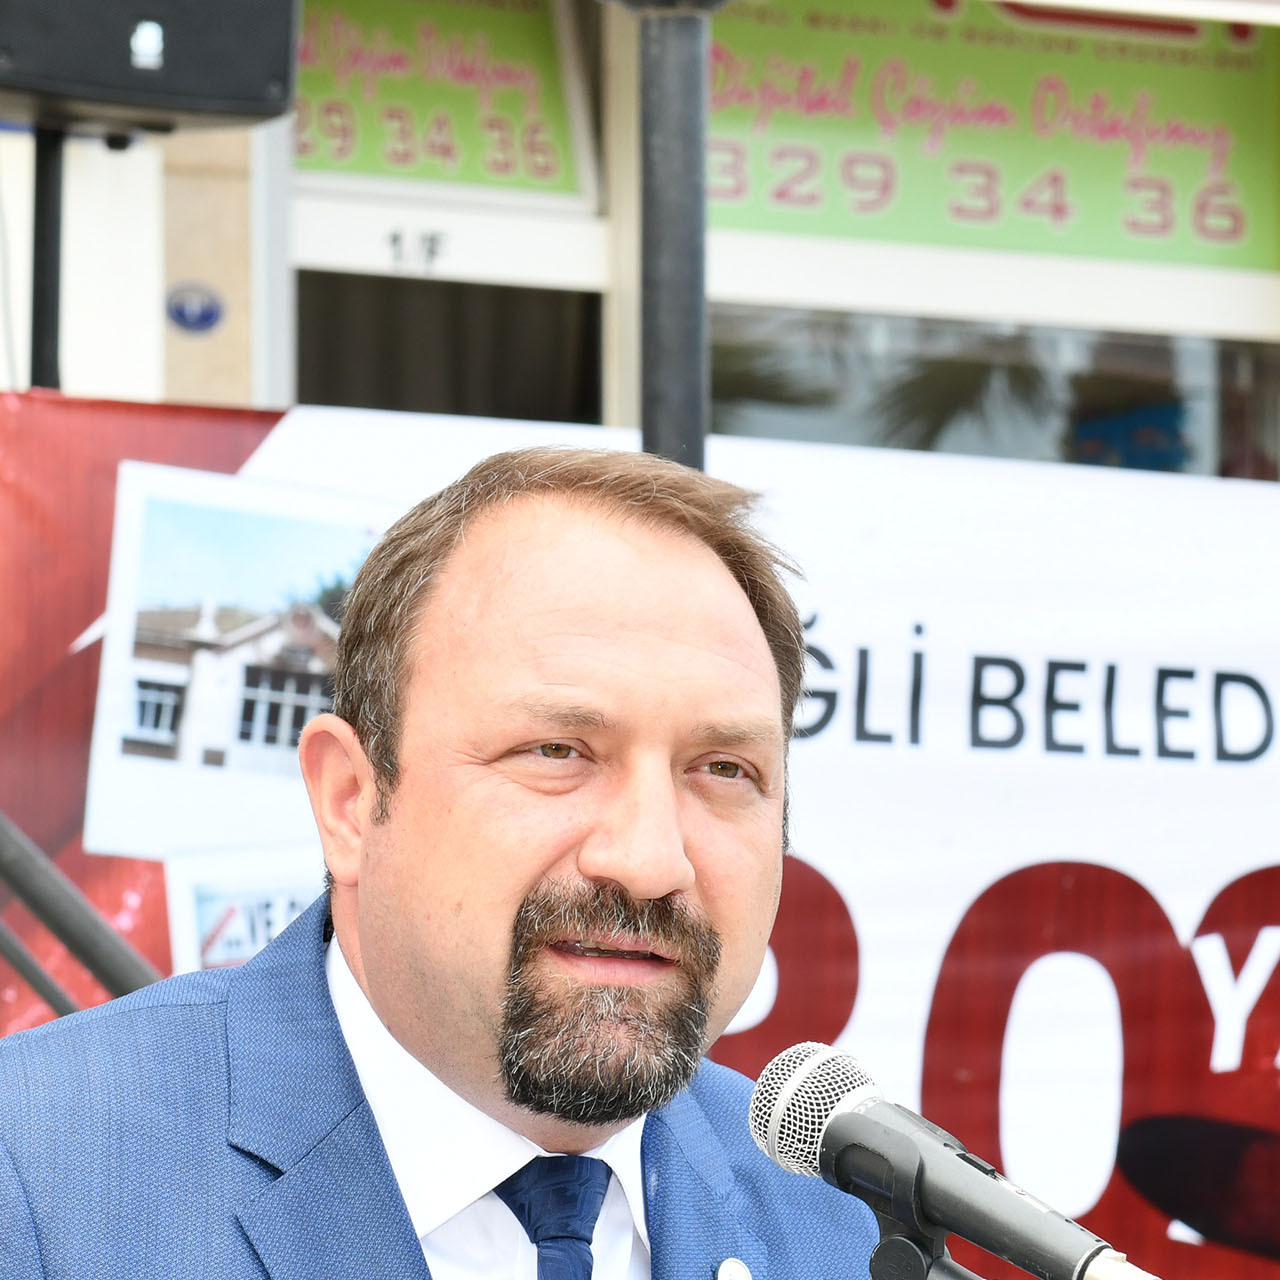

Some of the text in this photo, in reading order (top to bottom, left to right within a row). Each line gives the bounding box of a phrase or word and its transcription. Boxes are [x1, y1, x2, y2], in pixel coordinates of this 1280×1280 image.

[378, 103, 461, 172] 34
[480, 112, 563, 184] 36
[707, 138, 1250, 245] 329 34 36
